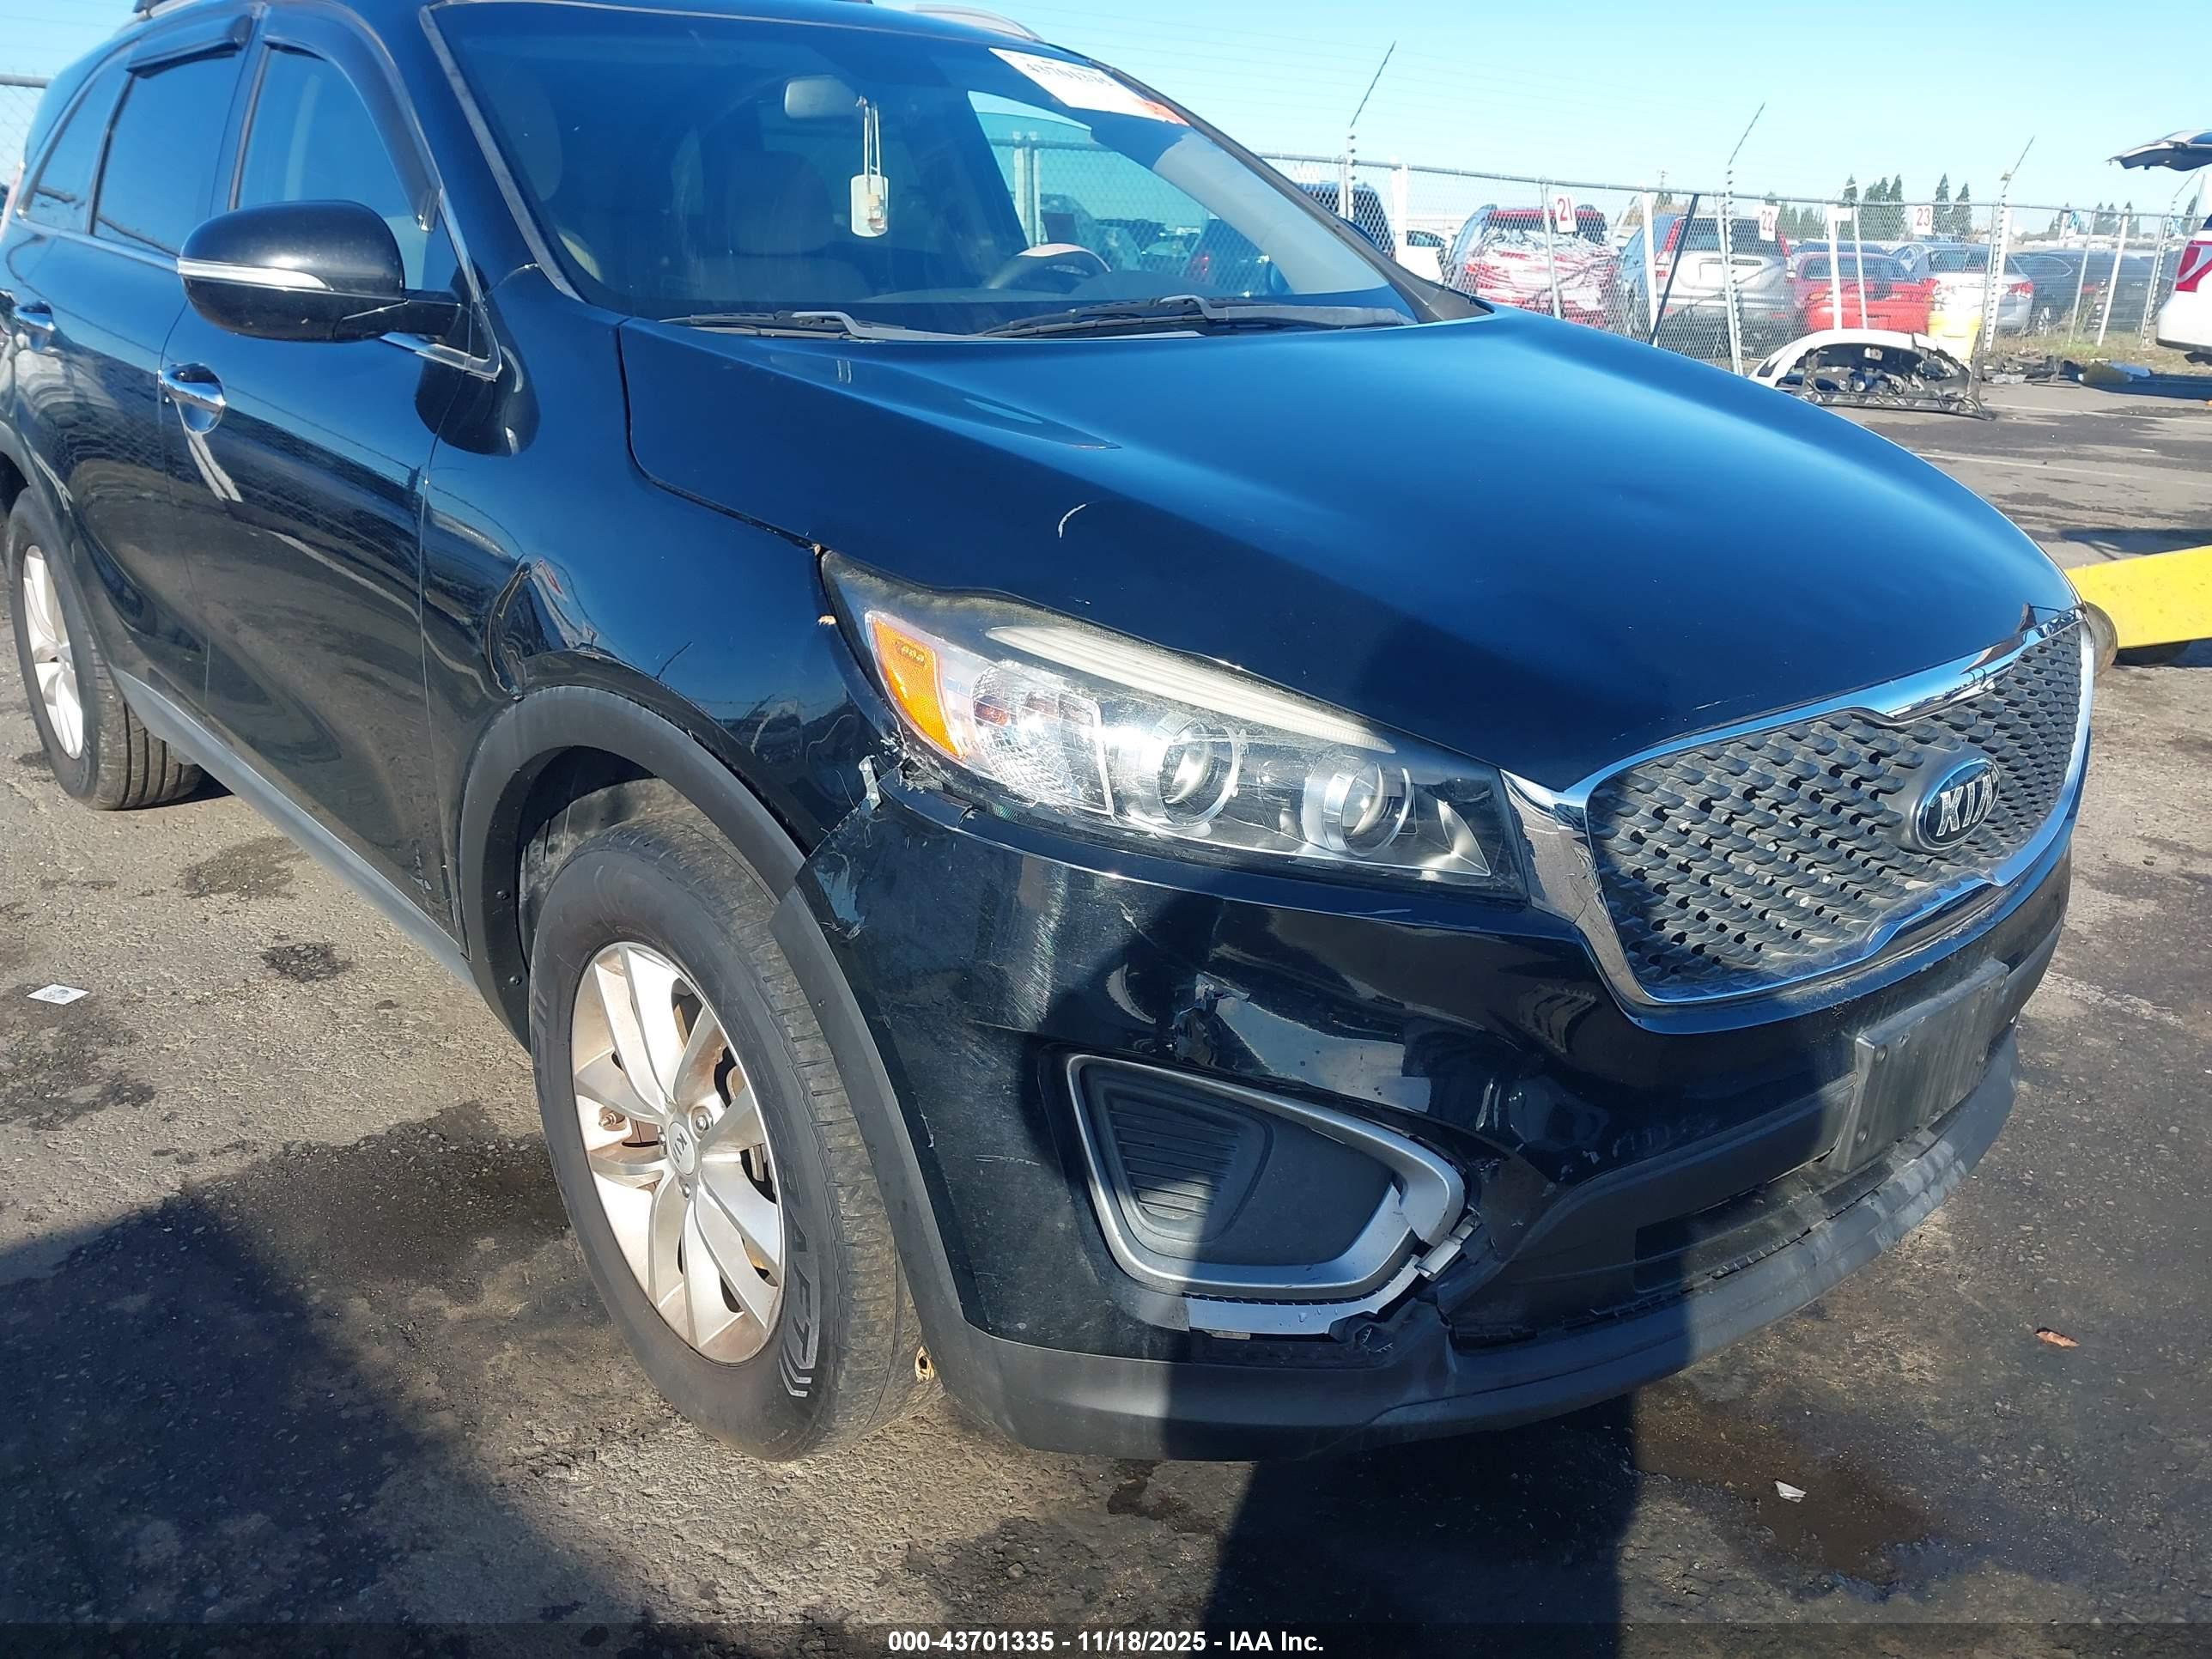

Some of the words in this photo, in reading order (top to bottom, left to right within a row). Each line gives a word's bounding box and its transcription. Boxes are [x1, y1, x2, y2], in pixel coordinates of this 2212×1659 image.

[1557, 197, 1573, 222] 21
[1761, 210, 1773, 232] 22
[1916, 207, 1930, 227] 23
[1936, 773, 1995, 837] KIA
